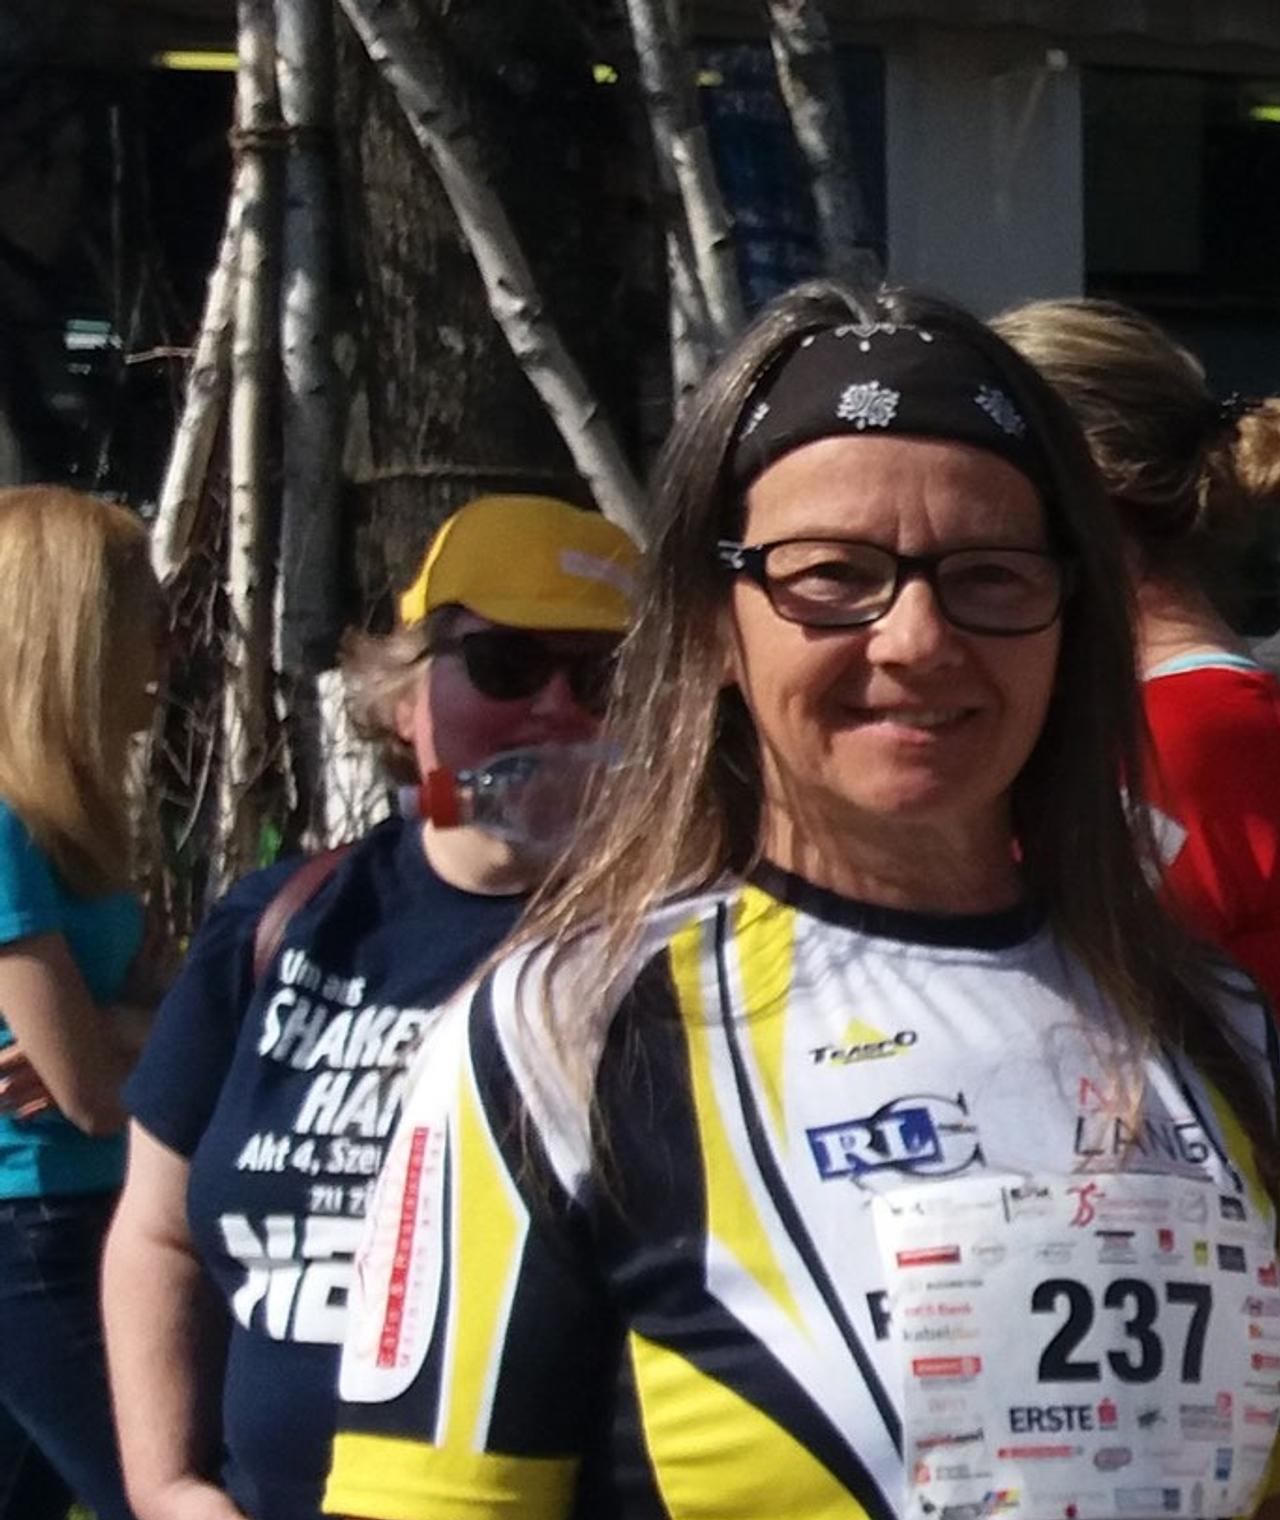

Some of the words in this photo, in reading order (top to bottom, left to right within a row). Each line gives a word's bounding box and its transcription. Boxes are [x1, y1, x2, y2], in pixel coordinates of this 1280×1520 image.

[237, 1132, 291, 1173] Akt
[1074, 1115, 1210, 1164] LANG
[1030, 1278, 1214, 1384] 237
[1009, 1404, 1095, 1434] ERSTE
